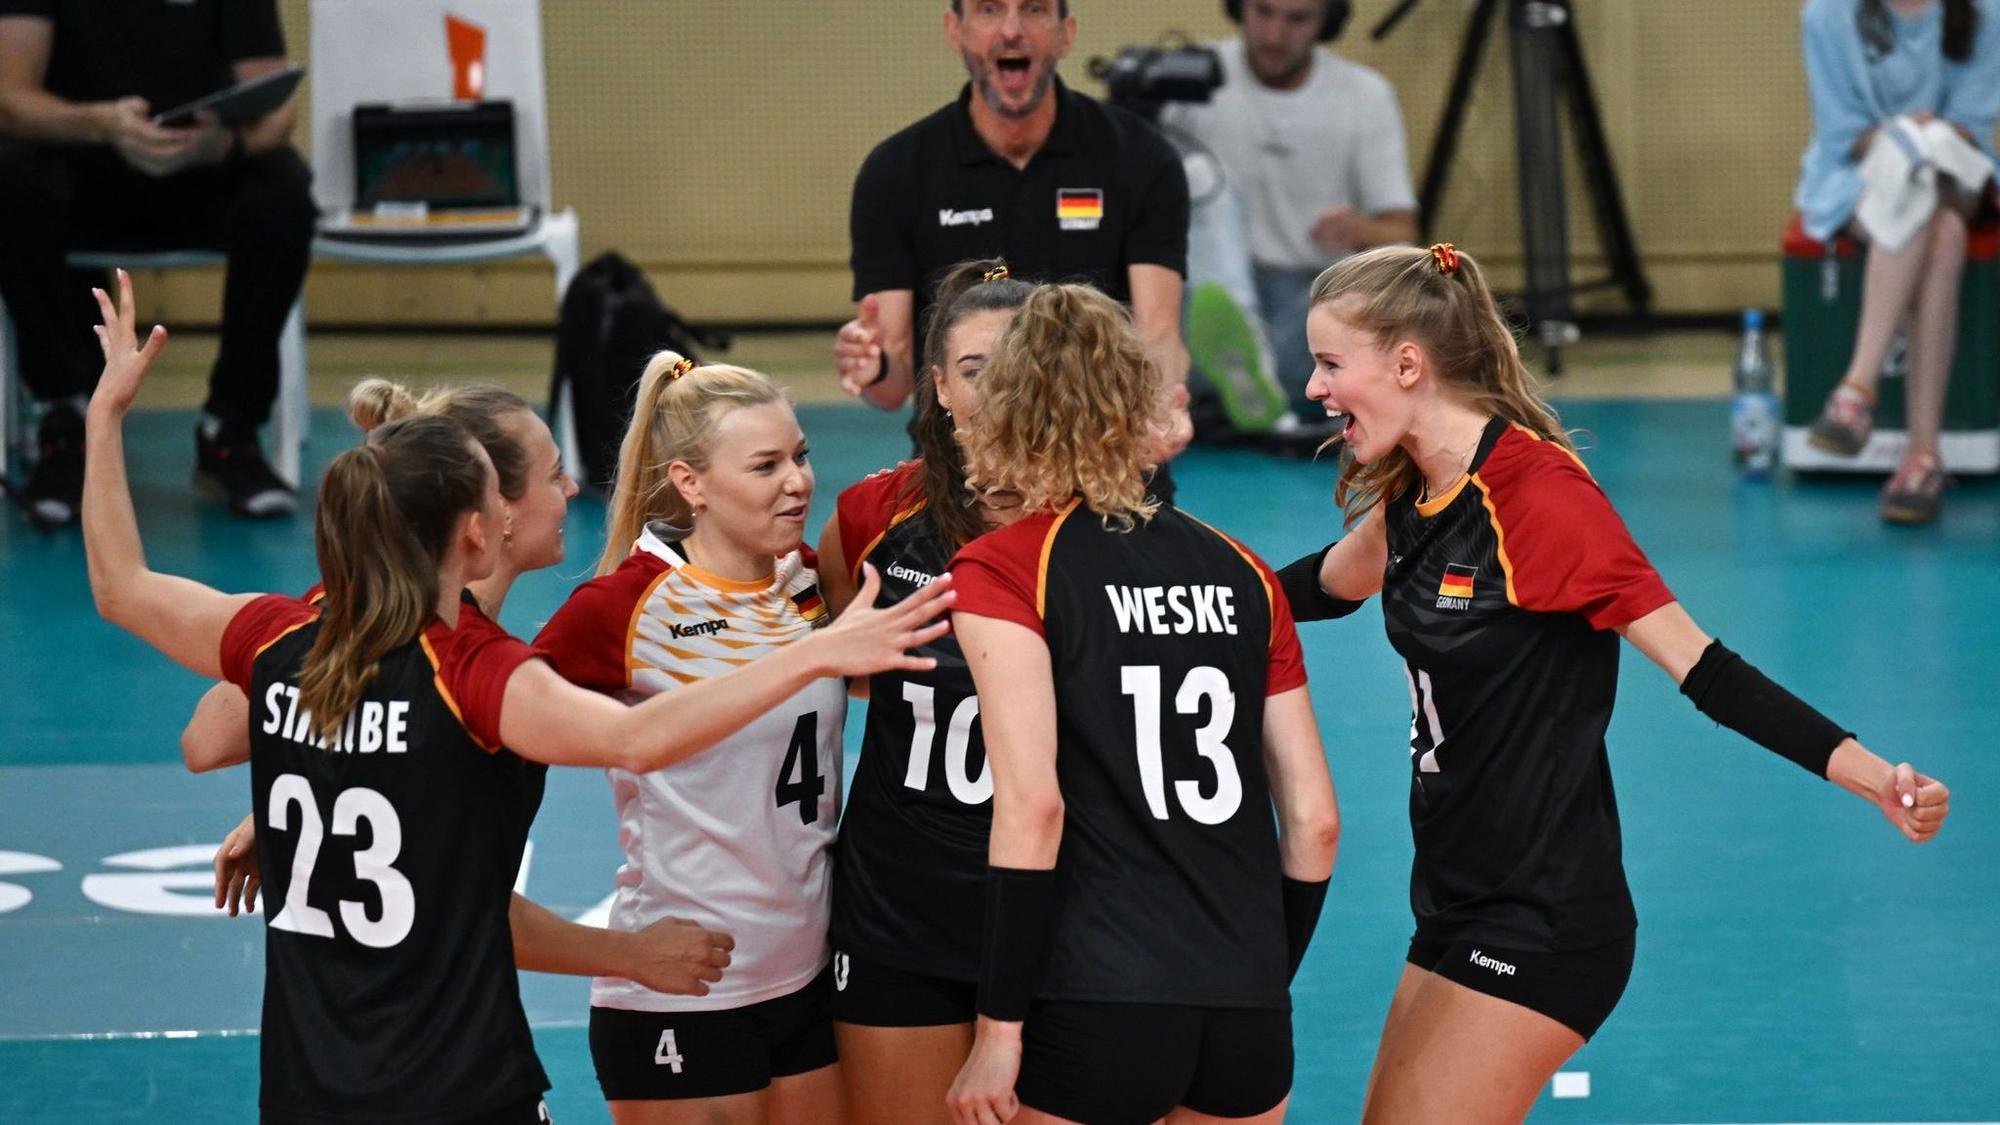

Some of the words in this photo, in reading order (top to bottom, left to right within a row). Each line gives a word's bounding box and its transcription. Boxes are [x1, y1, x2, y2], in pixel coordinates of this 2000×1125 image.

[887, 561, 936, 587] emp
[669, 618, 729, 640] Kempa
[1105, 584, 1239, 635] WESKE
[262, 681, 410, 754] STBE
[775, 710, 825, 826] 4
[1120, 665, 1243, 826] 13
[268, 773, 416, 948] 23
[1469, 948, 1517, 976] Kempa
[654, 1028, 684, 1074] 4
